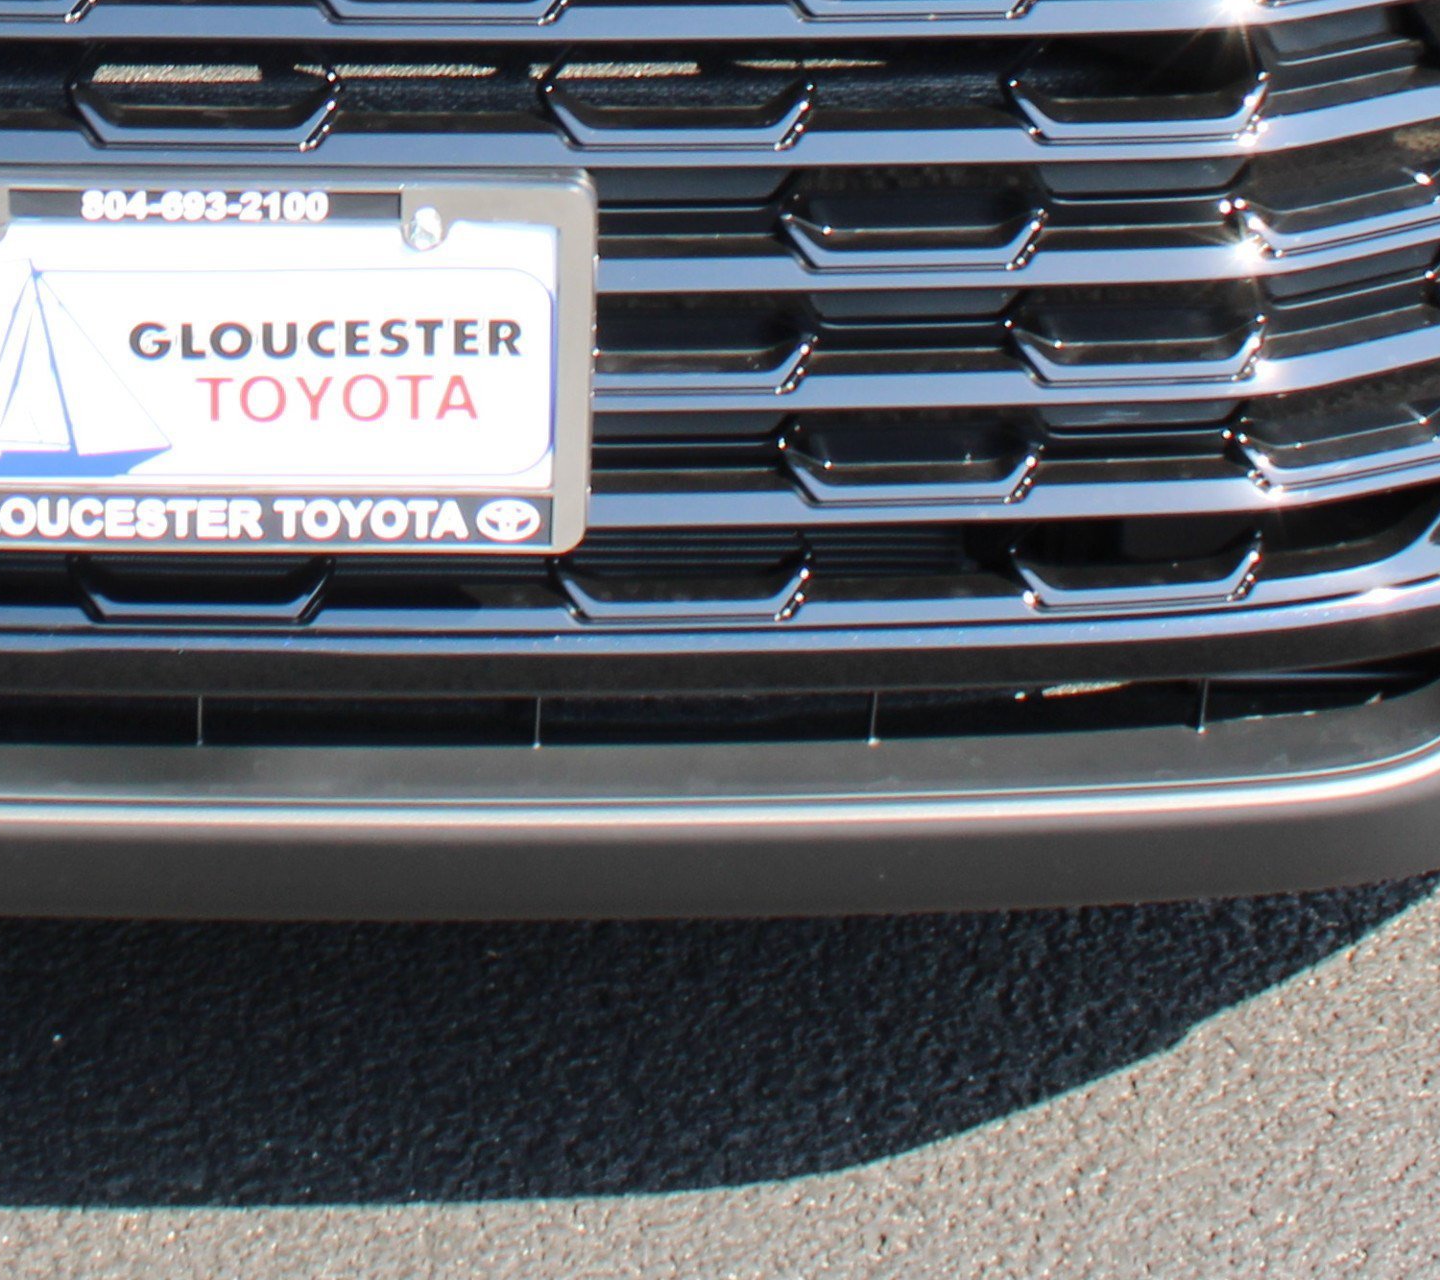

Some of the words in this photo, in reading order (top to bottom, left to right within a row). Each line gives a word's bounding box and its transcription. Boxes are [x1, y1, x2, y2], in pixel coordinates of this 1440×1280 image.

[81, 189, 330, 222] 804-693-2100
[128, 318, 523, 361] GLOUCESTER
[194, 374, 479, 423] TOYOTA
[273, 497, 468, 540] TOYOTA
